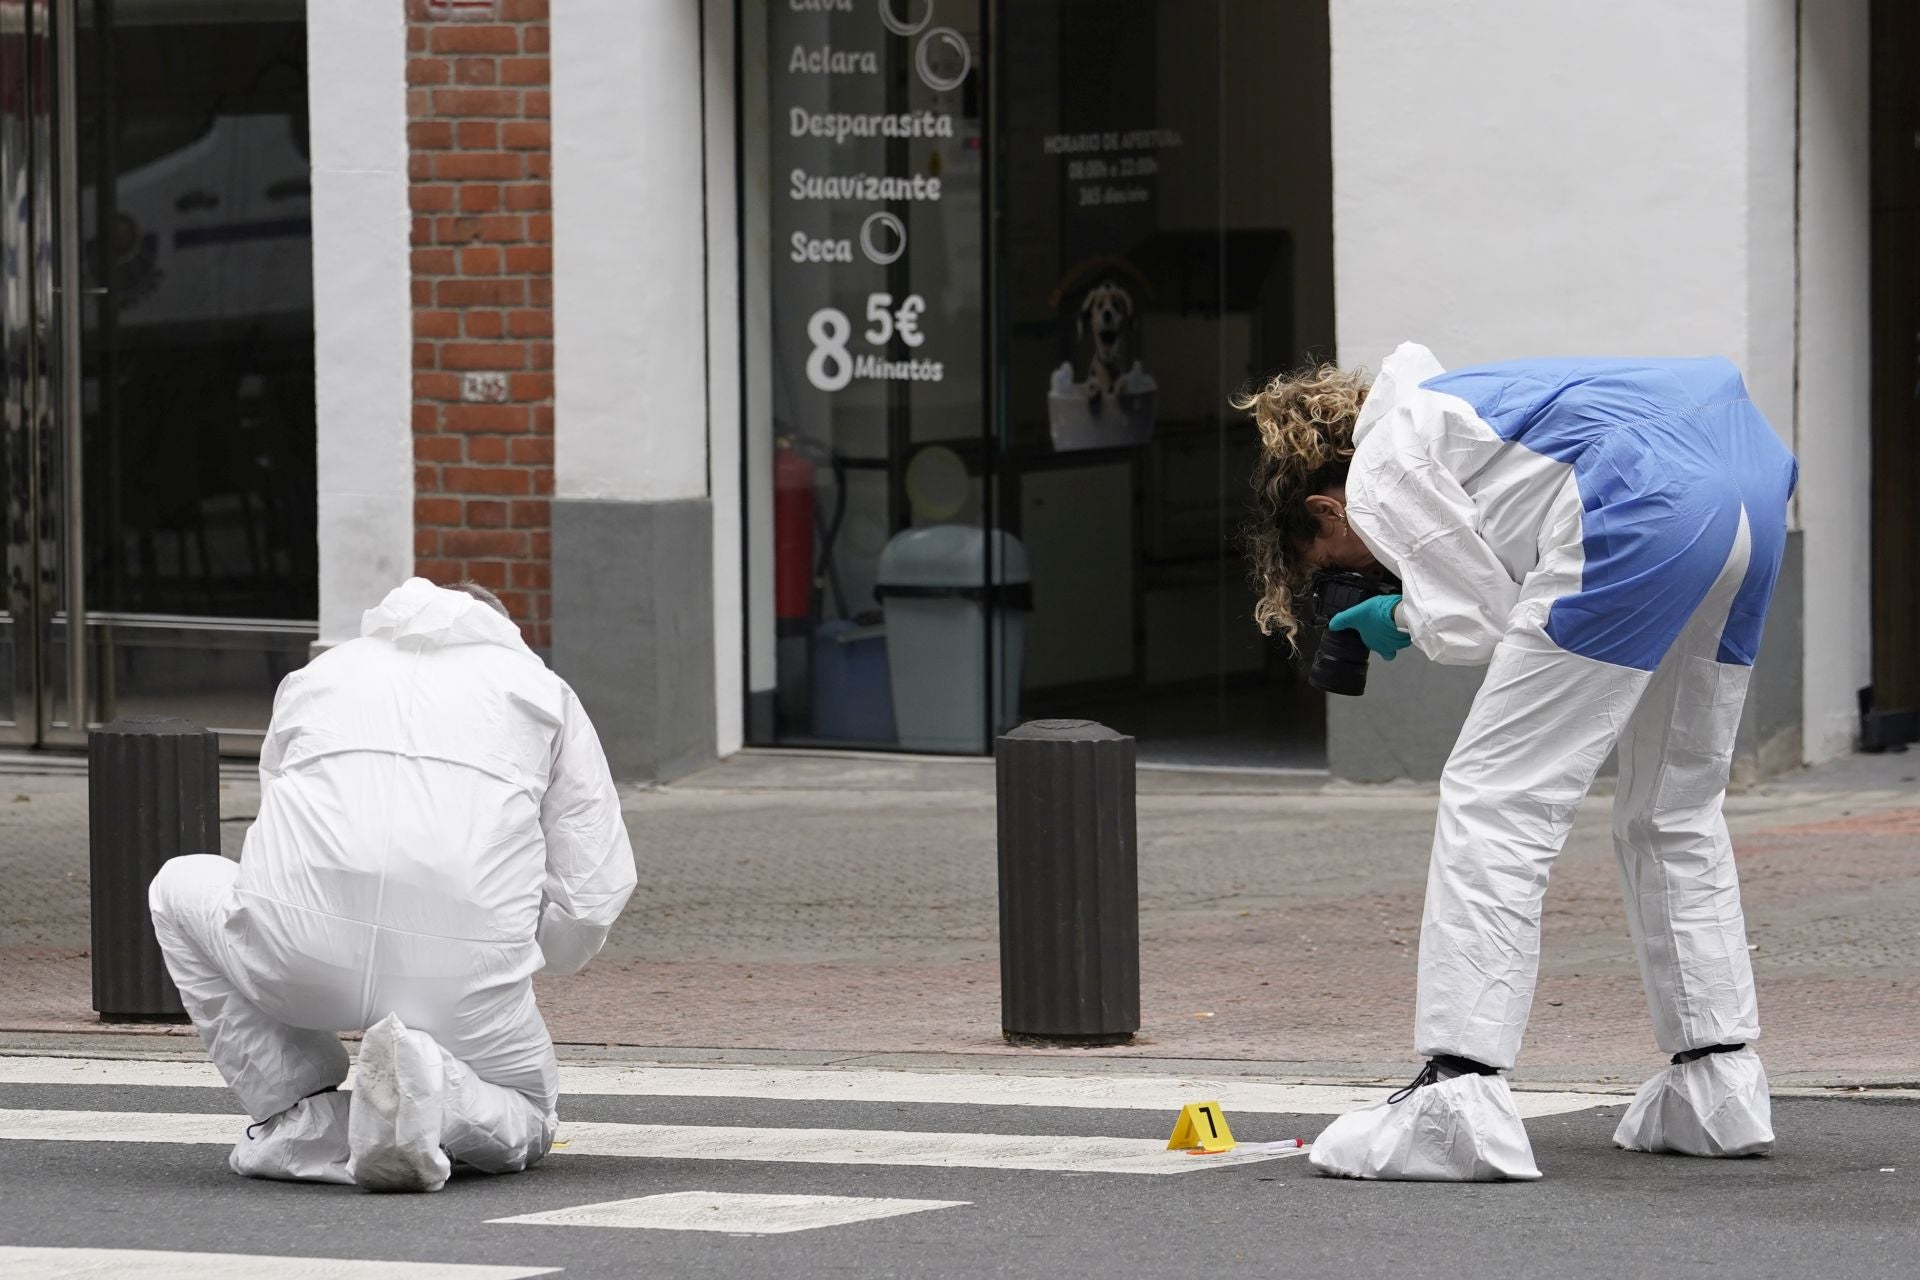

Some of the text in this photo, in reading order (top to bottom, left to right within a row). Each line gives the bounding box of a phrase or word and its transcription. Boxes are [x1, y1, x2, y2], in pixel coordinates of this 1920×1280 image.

[789, 45, 878, 74] Aclara
[789, 107, 954, 145] Desparasita
[790, 168, 942, 201] Suavizante
[790, 230, 853, 263] Seca
[865, 292, 926, 347] 5€
[806, 307, 853, 392] 8
[1198, 1106, 1218, 1139] 1
